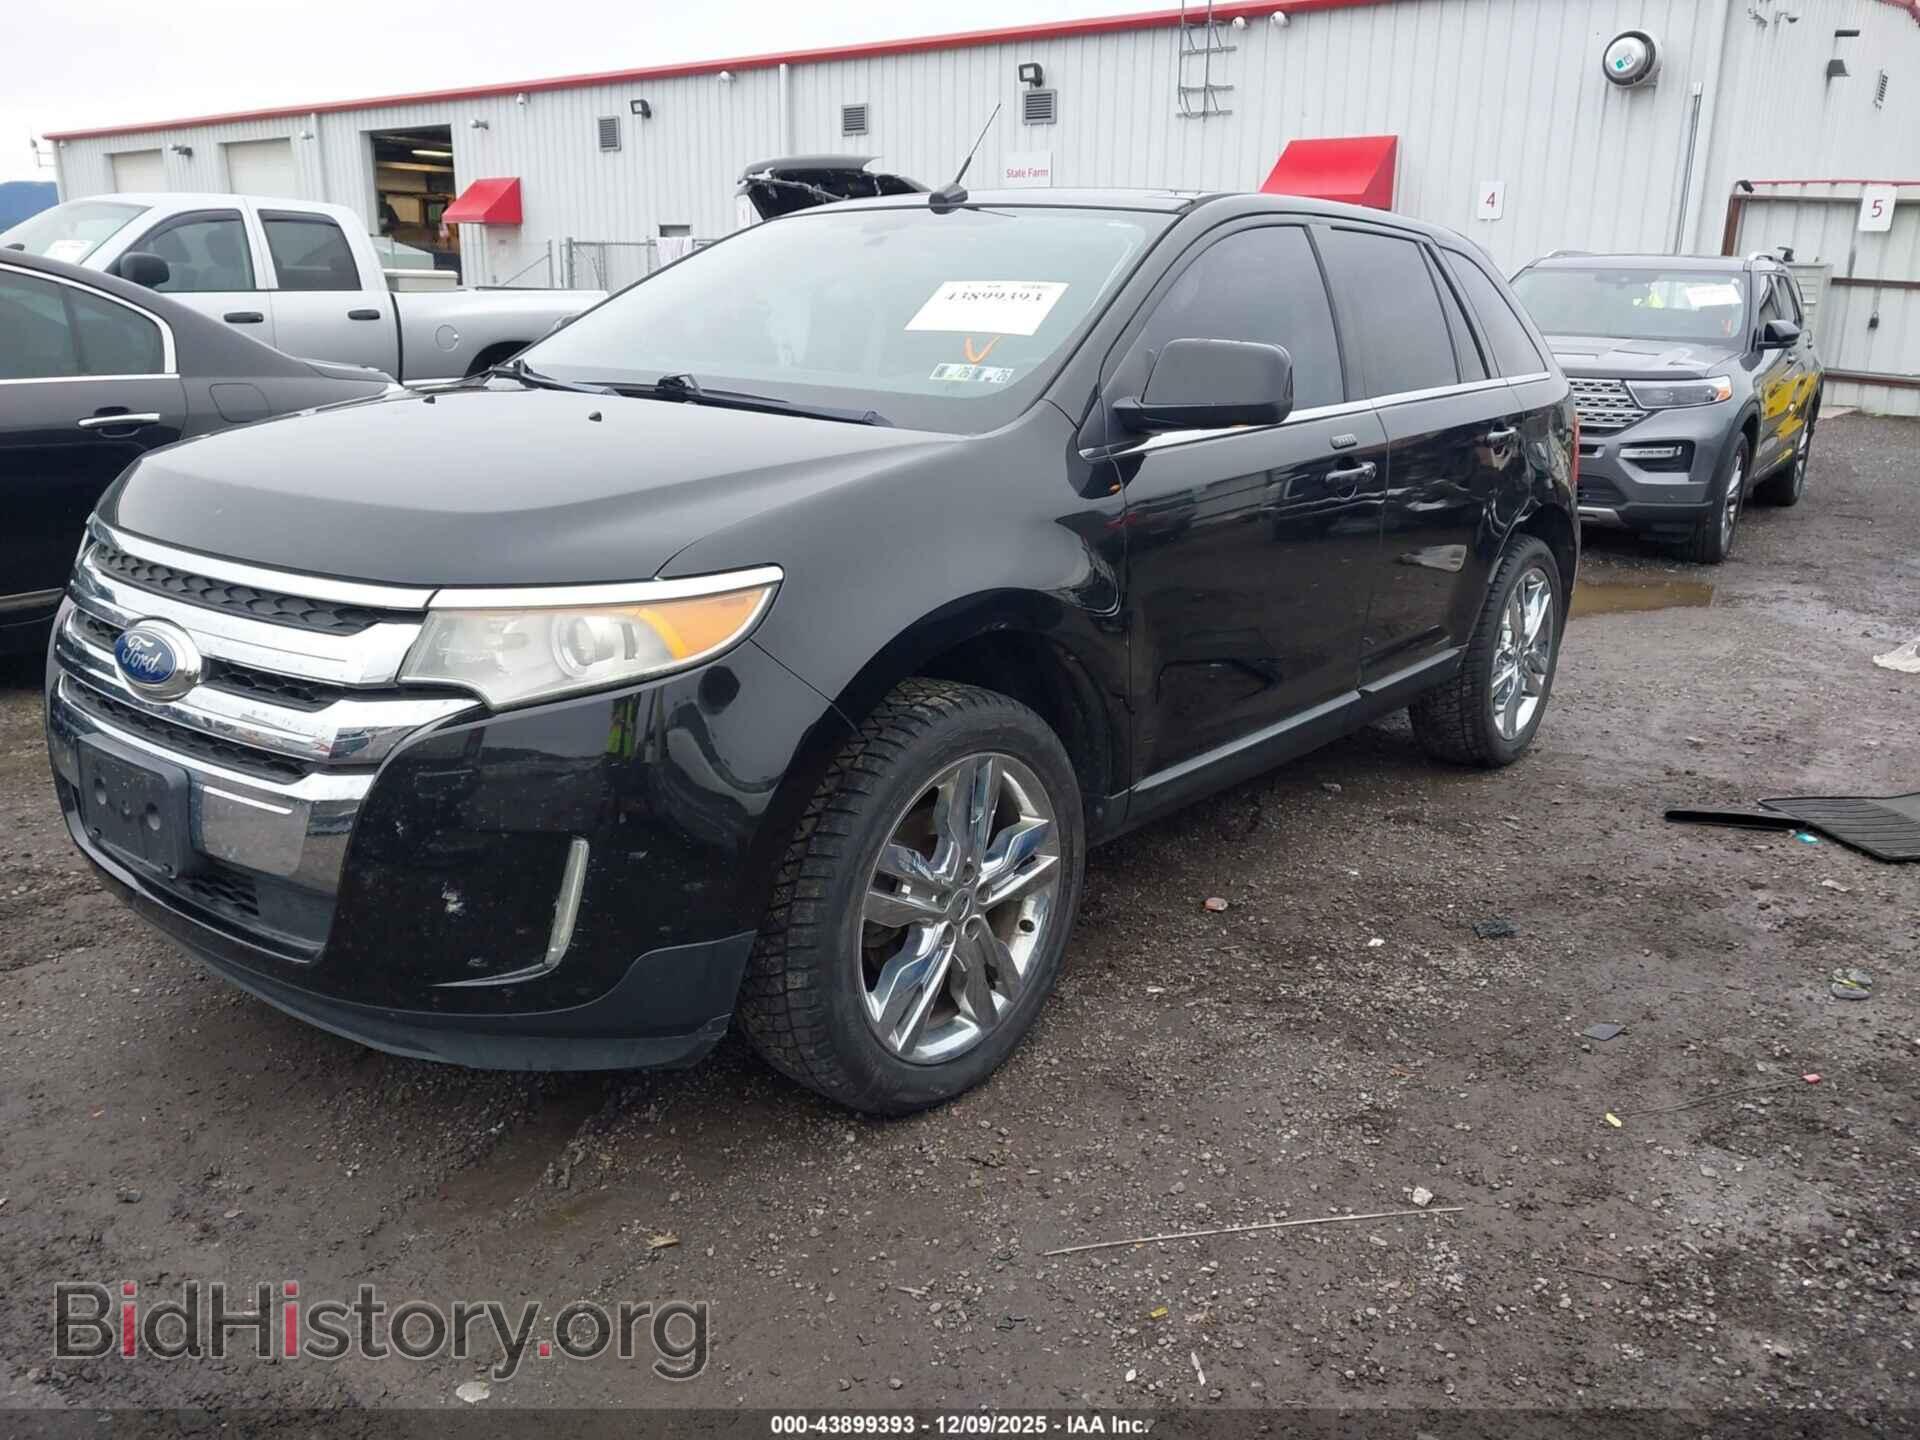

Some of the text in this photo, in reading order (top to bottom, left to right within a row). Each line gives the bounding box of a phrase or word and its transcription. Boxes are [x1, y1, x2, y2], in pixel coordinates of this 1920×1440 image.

[1006, 168, 1049, 178] State Farm
[1485, 191, 1496, 208] 4
[1872, 199, 1884, 217] 5
[122, 635, 162, 673] Ford
